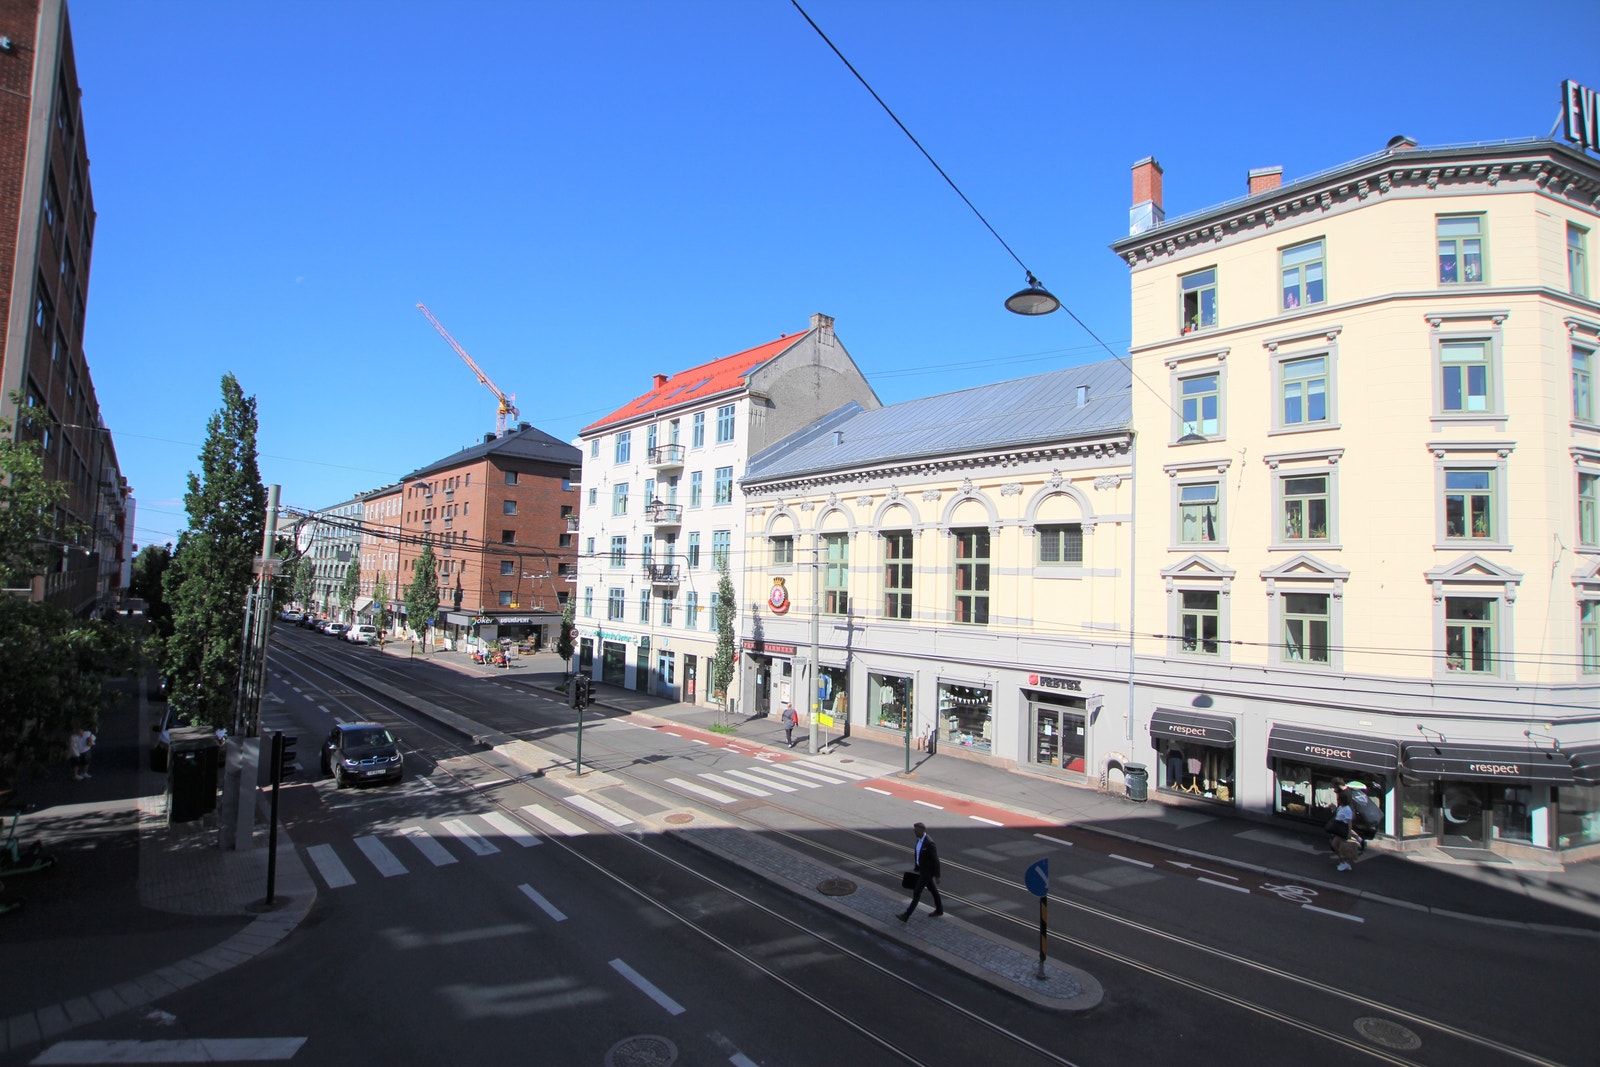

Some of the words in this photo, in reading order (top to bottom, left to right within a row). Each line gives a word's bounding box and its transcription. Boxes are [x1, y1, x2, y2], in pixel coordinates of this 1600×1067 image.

[1173, 726, 1206, 737] respect
[1310, 745, 1352, 759] respect
[1476, 763, 1519, 775] respect
